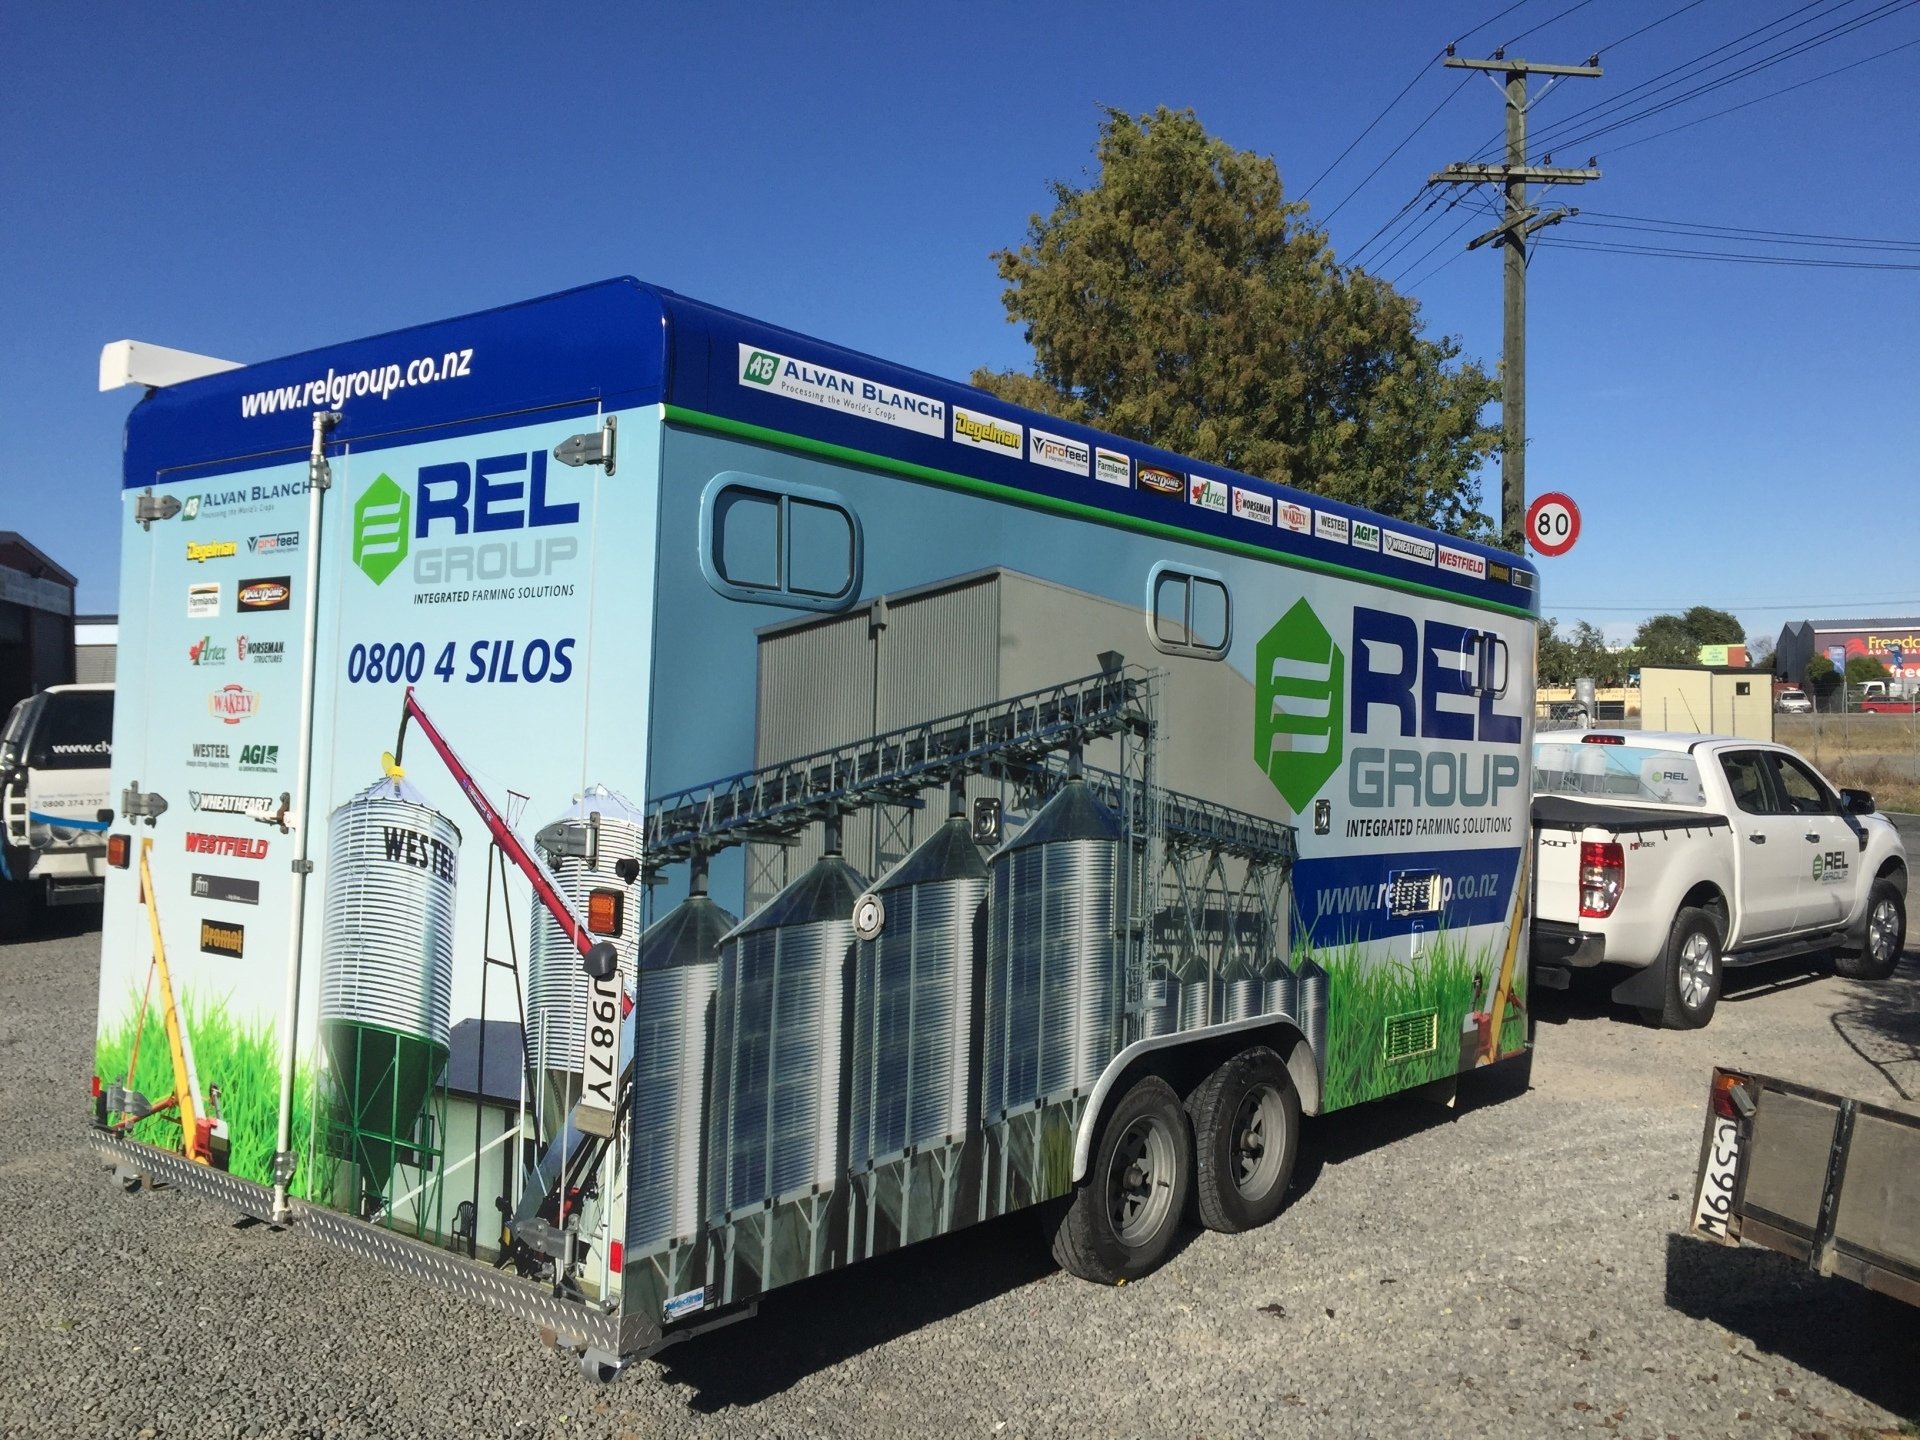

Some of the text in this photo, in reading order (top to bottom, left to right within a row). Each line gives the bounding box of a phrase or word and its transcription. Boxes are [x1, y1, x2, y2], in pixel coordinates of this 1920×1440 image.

[749, 354, 775, 380] AB
[241, 348, 473, 418] www.relgroup.co.nz
[784, 361, 943, 419] ALVAN BLANCH
[781, 381, 896, 420] Processing the World's Crops
[1045, 442, 1088, 465] profeed
[1098, 460, 1128, 476] Farmlands
[203, 481, 311, 507] ALVAN BLANCH
[415, 449, 580, 539] REL
[1320, 515, 1347, 532] WESTEEL
[1354, 524, 1371, 541] AGI
[1538, 512, 1568, 536] 80
[413, 536, 578, 585] GROUP
[1392, 537, 1434, 561] WHEATHEART
[1439, 550, 1484, 574] WESTFIELD
[414, 584, 575, 605] INTEGRATED FARMING SOLUTIONS
[247, 641, 285, 655] NORSEMAN
[348, 637, 576, 684] 0800 4 SILOS
[1351, 606, 1522, 744] REL
[192, 743, 230, 759] WESTEEL
[239, 744, 267, 765] AGI
[1349, 747, 1520, 808] GROUP
[1663, 771, 1689, 781] REL
[200, 792, 273, 813] WHEATHEART
[1346, 816, 1513, 838] INTEGRATED FARMING SOLUTIONS
[185, 831, 269, 860] WESTFIELD
[1824, 850, 1849, 871] REL
